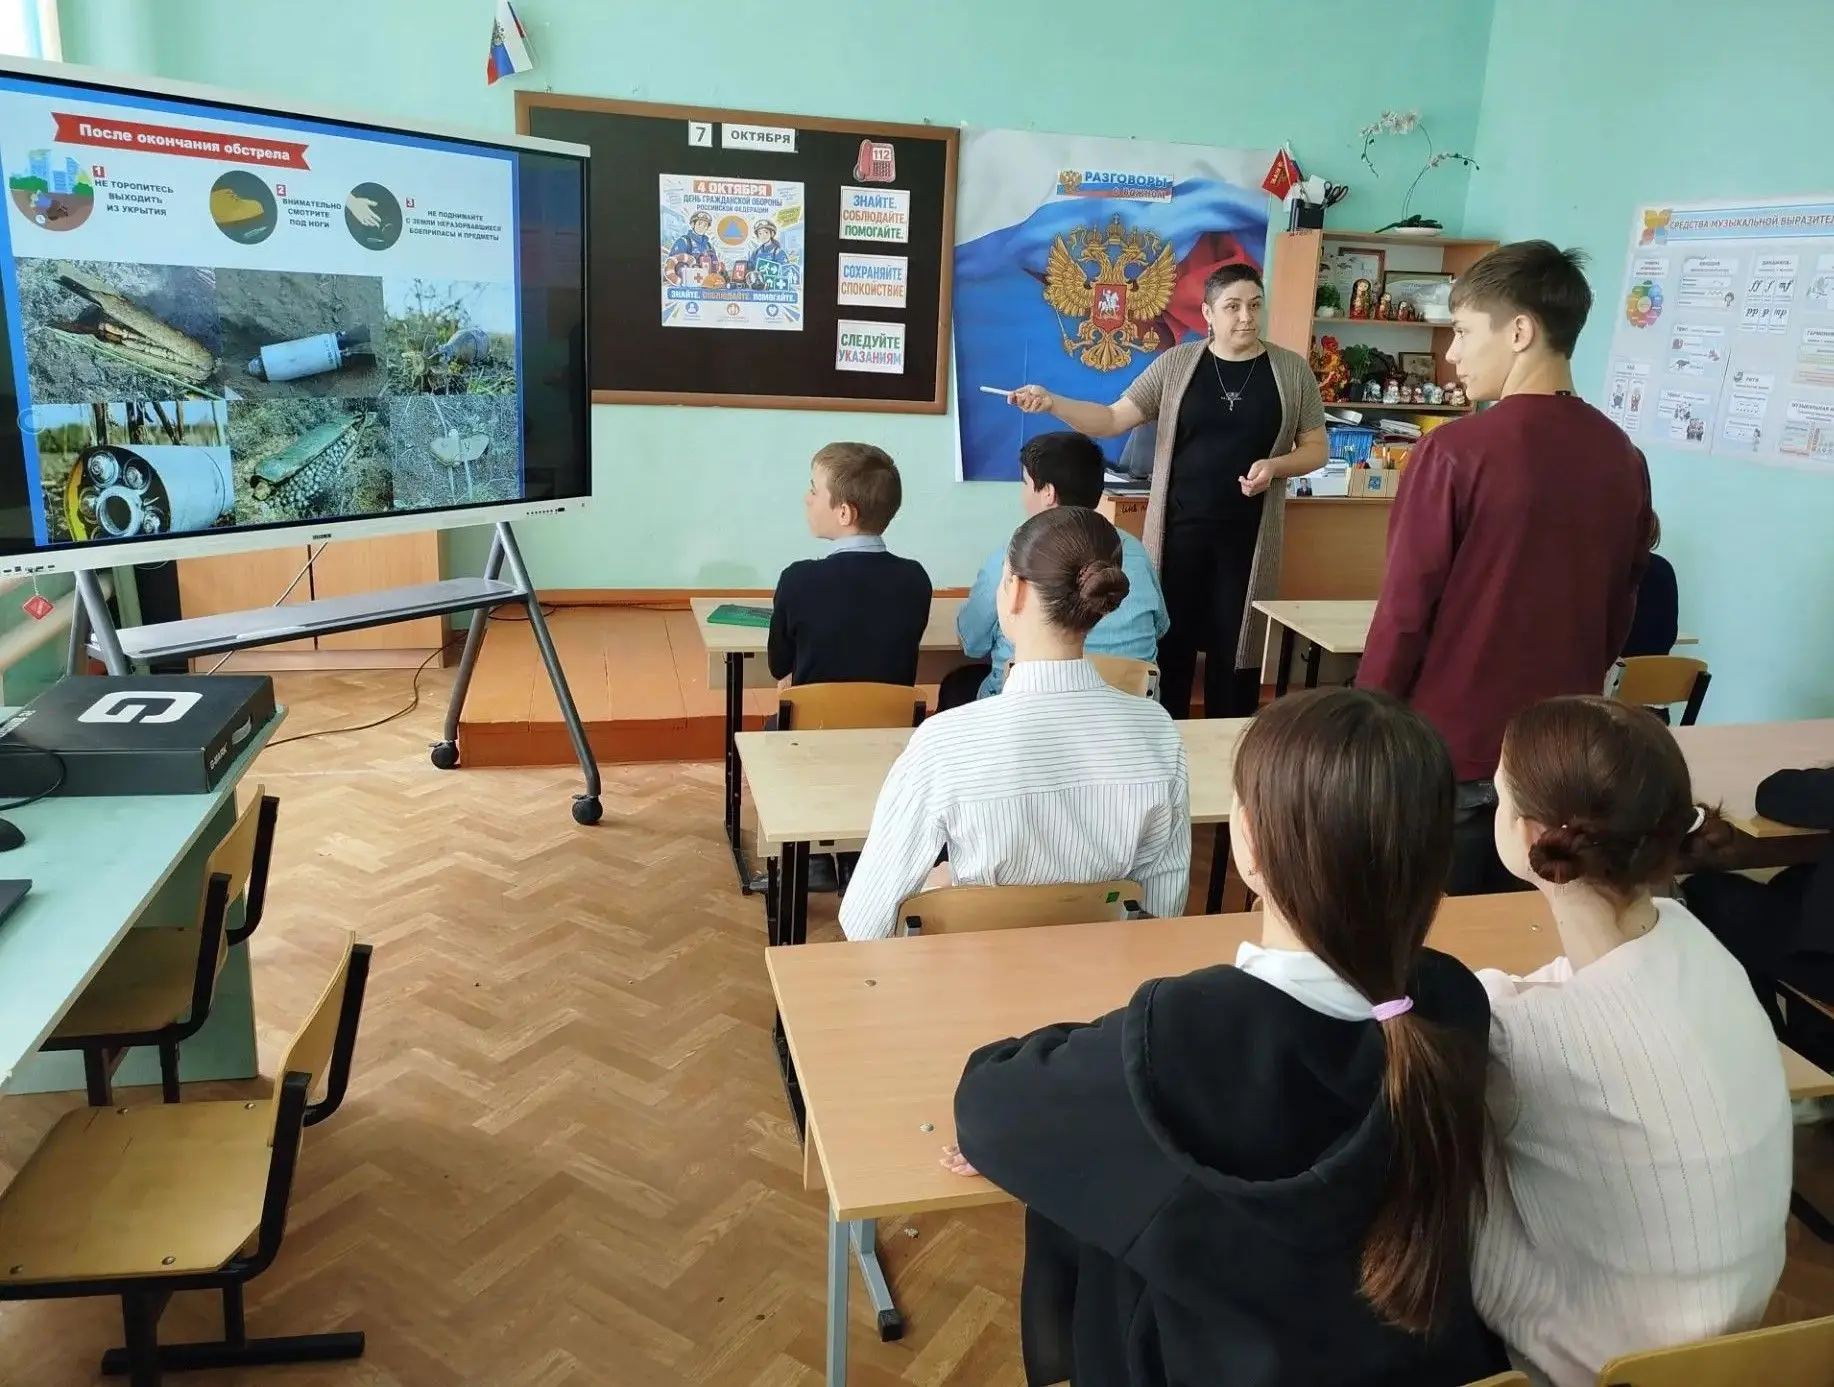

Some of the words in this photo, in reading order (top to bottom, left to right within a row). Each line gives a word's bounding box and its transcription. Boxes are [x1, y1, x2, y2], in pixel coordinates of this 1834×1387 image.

[79, 123, 132, 142] После
[137, 132, 220, 153] окончания
[224, 143, 290, 161] обстрела
[695, 126, 706, 142] 7
[730, 130, 791, 144] ОКТЯБРЯ
[874, 150, 890, 160] 112
[95, 179, 108, 187] НЕ
[110, 181, 174, 194] ТОРОПИТЕСЬ
[1085, 170, 1167, 188] РАЗГОВОРЫ
[697, 181, 706, 193] 4
[708, 182, 767, 196] ОКТЯБРЯ
[108, 192, 163, 204] ВЫХОДИТЬ
[282, 198, 342, 210] ВНИМАТЕЛЬНО
[683, 194, 700, 204] ДЕНЬ
[702, 195, 751, 206] ГРАЖДАНСКОЙ
[106, 204, 119, 212] ИЗ
[122, 205, 167, 216] УКРЫТИЯ
[287, 208, 330, 218] СМОТРИТЕ
[289, 219, 307, 227] ПОД
[308, 220, 330, 228] НОГИ
[1670, 219, 1709, 231] СРЕДСТВА
[1710, 214, 1779, 229] МУЗЫКАЛЬНОЙ
[843, 264, 903, 281] СОХРАНЯЙТЕ
[841, 280, 904, 297] СПОКОЙСТВИЕ
[840, 332, 900, 350] СЛЕДУЙТЕ
[839, 349, 901, 366] УКАЗАНИЯМ
